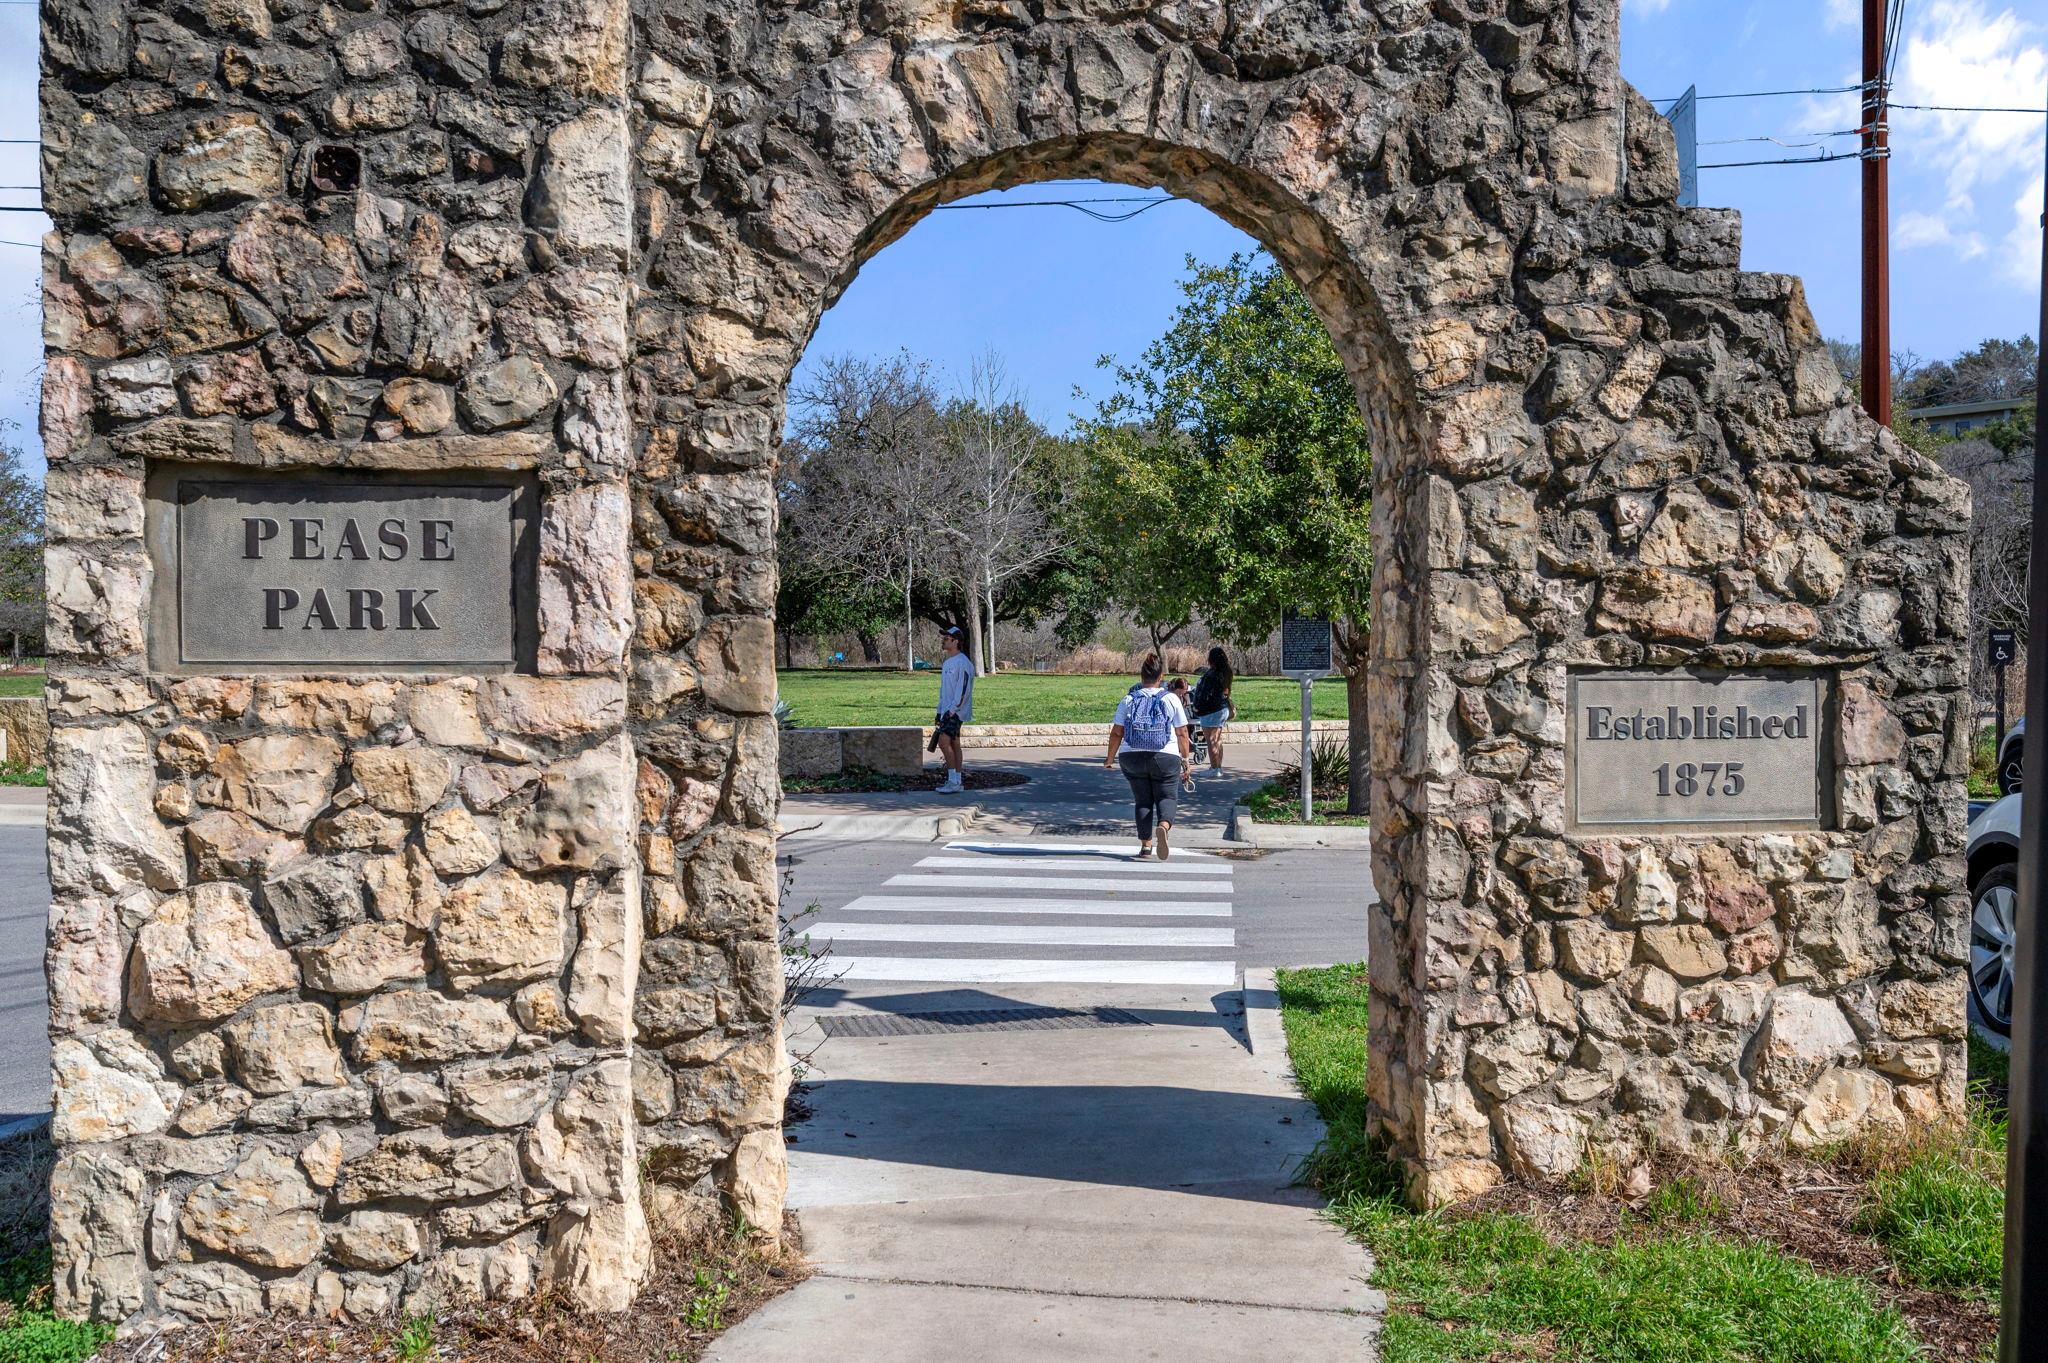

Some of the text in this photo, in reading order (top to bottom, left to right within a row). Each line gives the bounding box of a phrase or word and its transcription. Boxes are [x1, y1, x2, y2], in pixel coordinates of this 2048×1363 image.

[241, 517, 455, 561] PEASE
[262, 588, 441, 631] PARK
[1586, 704, 1809, 741] Established
[1652, 762, 1745, 797] 1875
